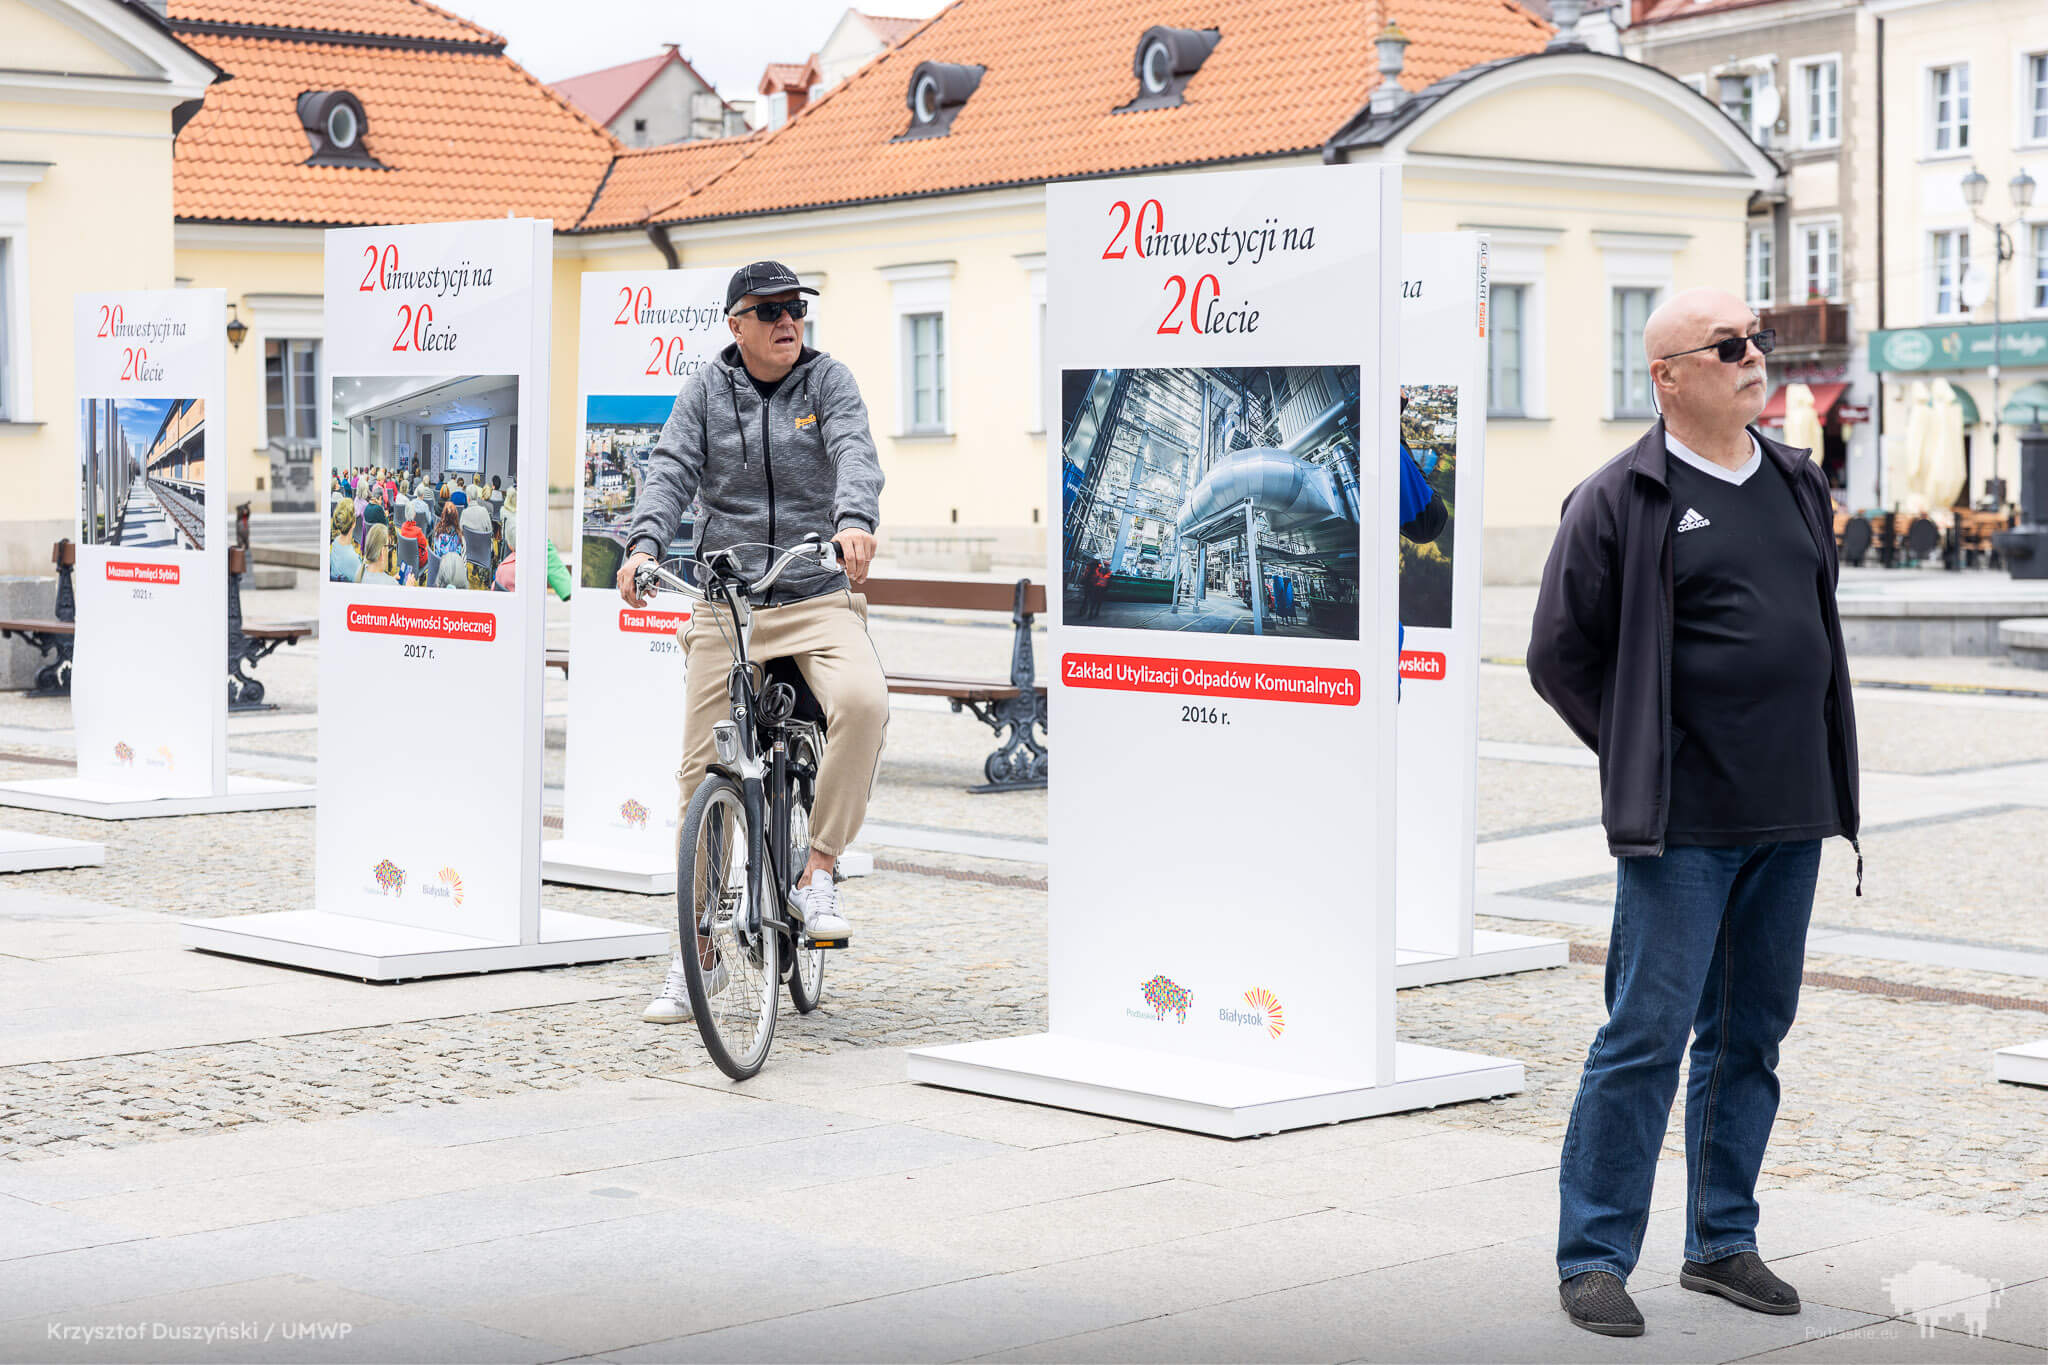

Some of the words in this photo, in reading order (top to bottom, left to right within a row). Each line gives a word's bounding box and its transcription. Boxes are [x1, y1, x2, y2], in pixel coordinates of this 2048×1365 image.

[1283, 226, 1316, 251] na
[472, 267, 493, 287] na
[172, 321, 186, 337] na
[1677, 518, 1711, 533] adidas
[350, 610, 388, 627] Centrum
[389, 613, 441, 631] Aktywności
[442, 616, 493, 637] Społecznej
[622, 613, 645, 627] Trasa
[404, 644, 428, 658] 2017
[429, 649, 435, 660] r.
[650, 640, 672, 653] 2019
[1067, 661, 1113, 680] Zakład
[1116, 663, 1179, 686] Utylizacji
[1182, 668, 1252, 691] Odpadów
[1254, 673, 1355, 698] Komunalnych
[1181, 705, 1218, 725] 2016
[1221, 711, 1231, 725] r.
[1219, 1008, 1264, 1027] Białystok
